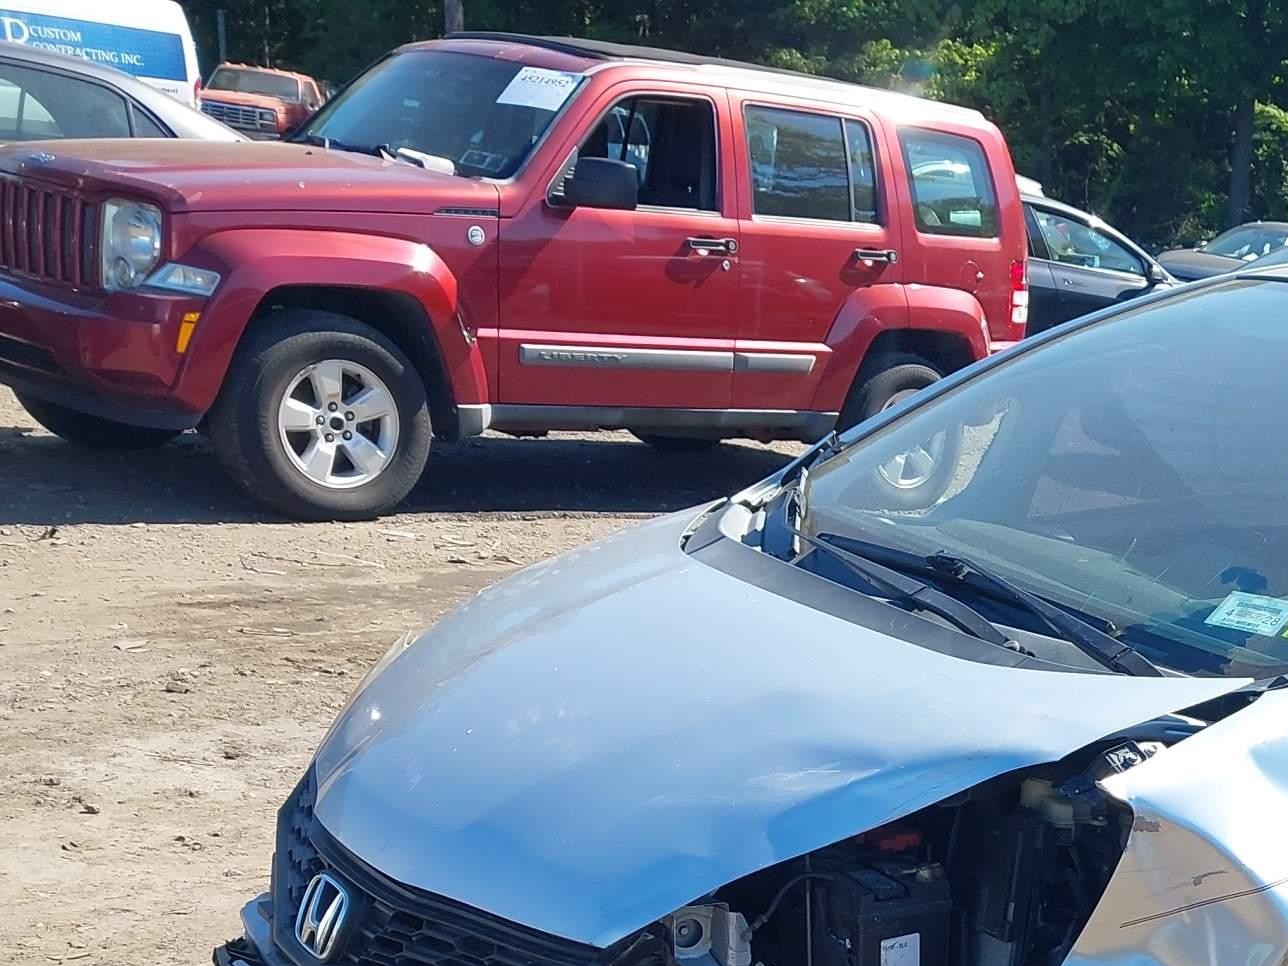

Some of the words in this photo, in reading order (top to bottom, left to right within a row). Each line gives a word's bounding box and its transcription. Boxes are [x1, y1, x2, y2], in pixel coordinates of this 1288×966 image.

[30, 25, 81, 43] CUSTOM
[32, 41, 119, 64] CONTRACTING
[121, 53, 144, 66] INC.
[539, 351, 628, 363] LIBERTY
